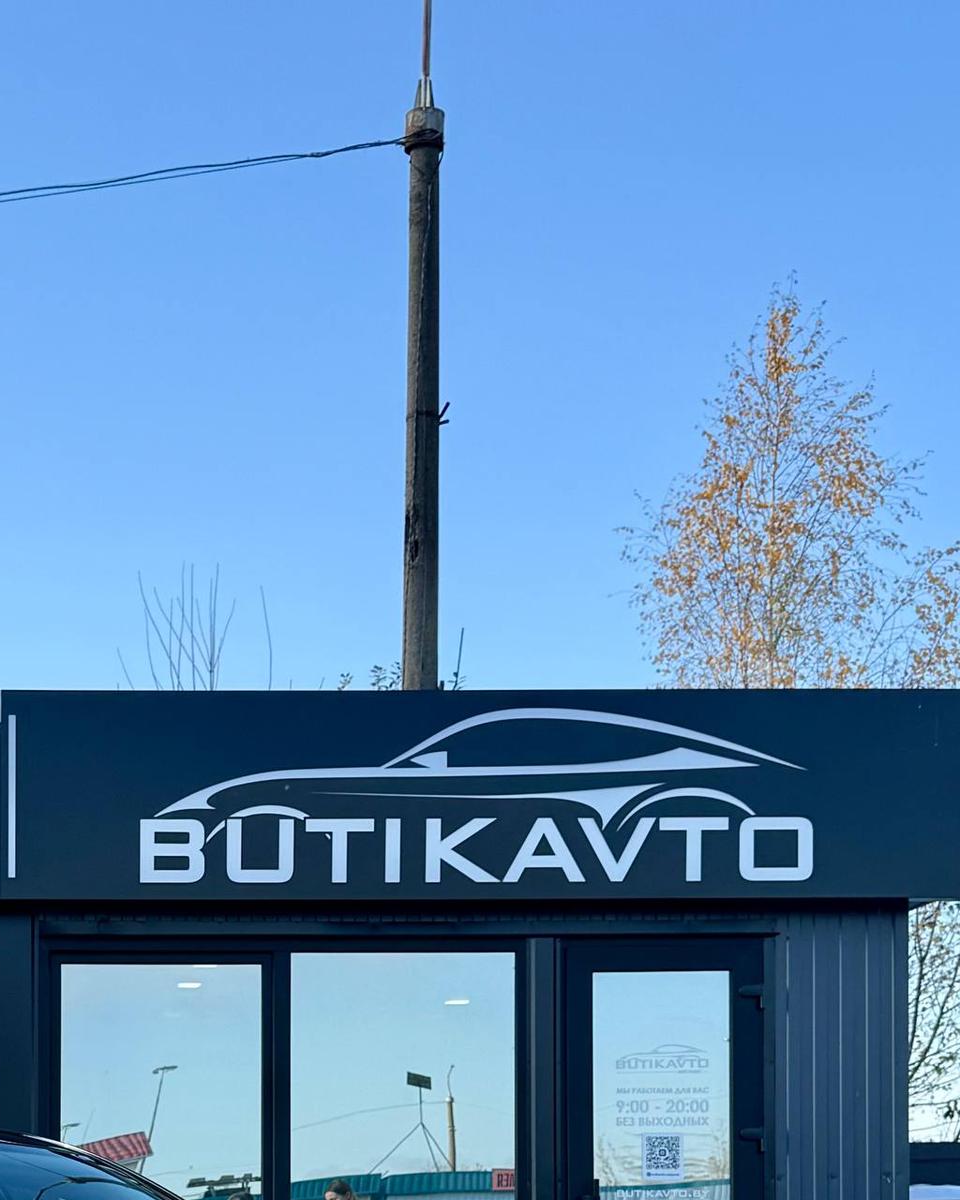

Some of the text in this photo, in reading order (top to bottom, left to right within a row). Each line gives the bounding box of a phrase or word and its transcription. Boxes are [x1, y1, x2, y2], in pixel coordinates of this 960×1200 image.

[139, 816, 813, 884] BUTIKAVTO
[615, 1059, 709, 1069] BUTIKAVTO
[615, 1099, 649, 1113] 9:00
[665, 1099, 709, 1113] 20:00
[615, 1117, 710, 1128] БЕЗ ВЫХОДНЫХ
